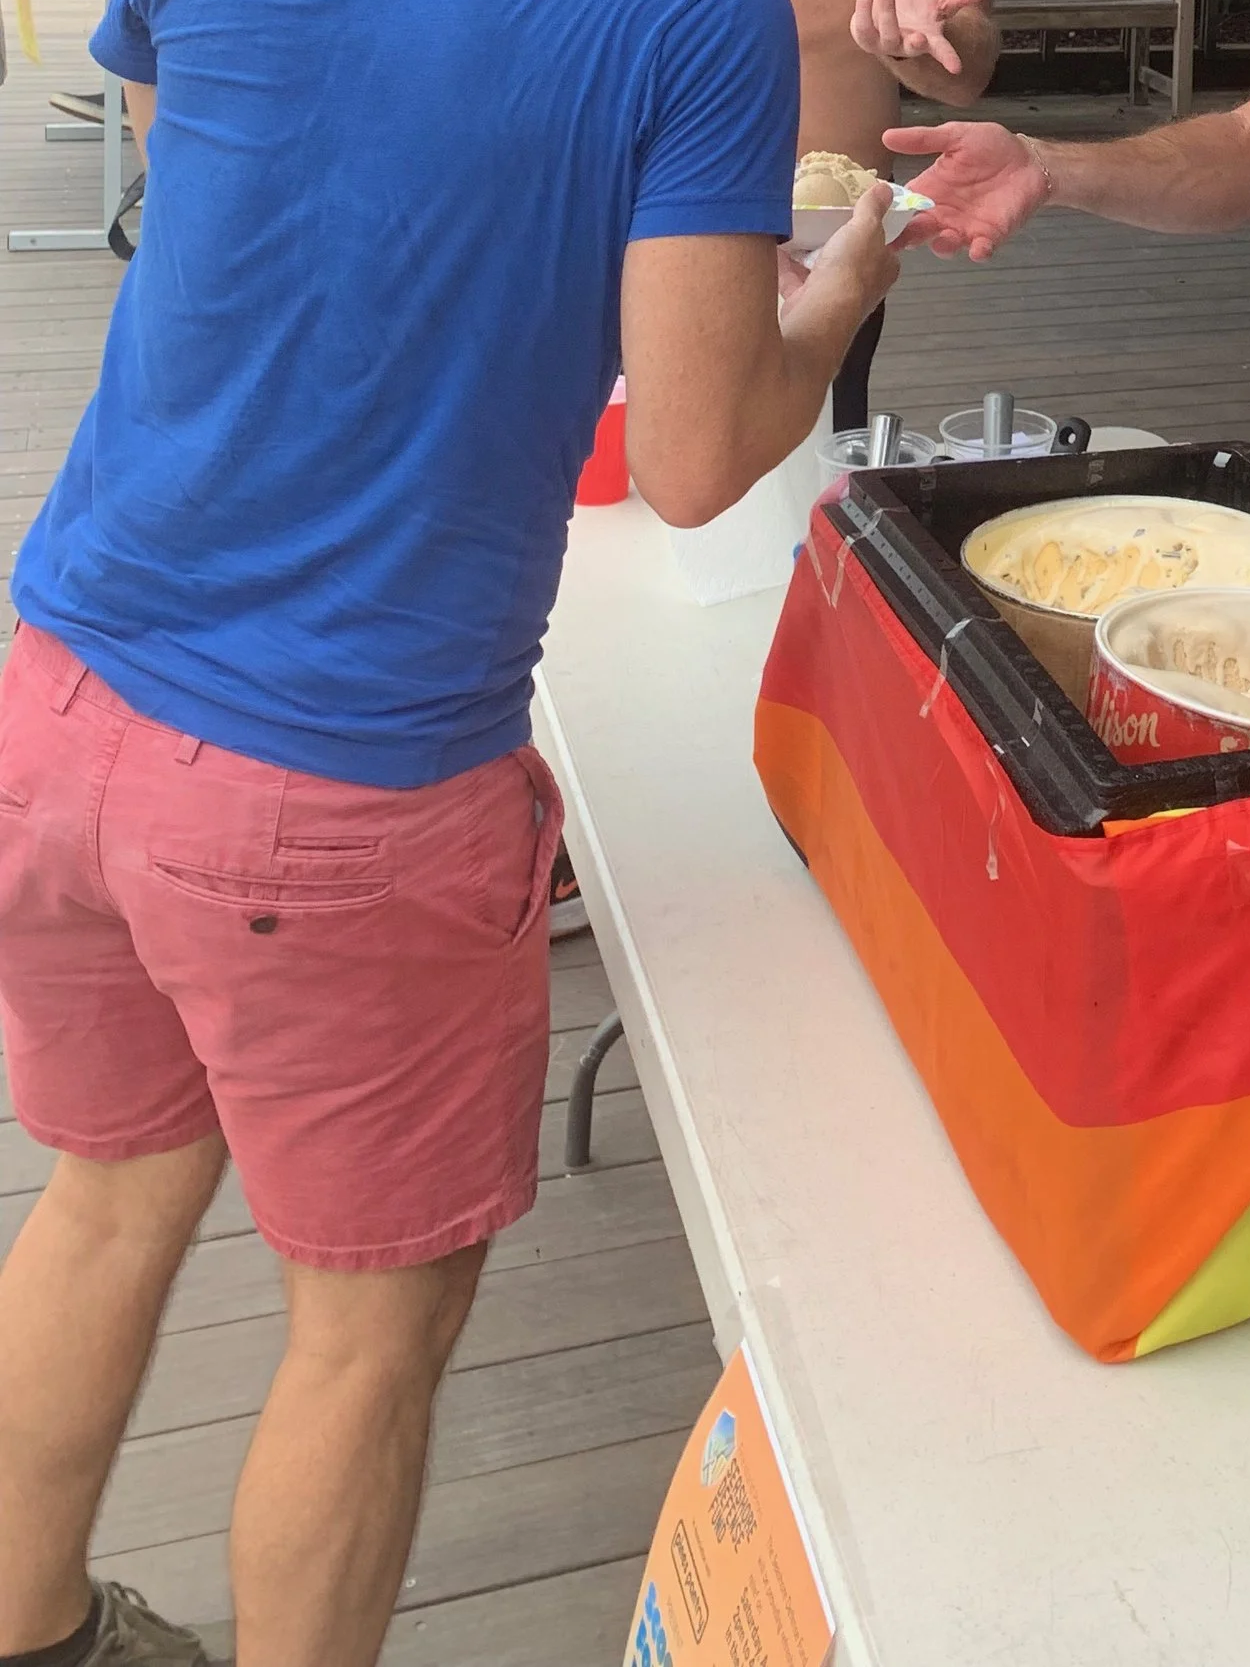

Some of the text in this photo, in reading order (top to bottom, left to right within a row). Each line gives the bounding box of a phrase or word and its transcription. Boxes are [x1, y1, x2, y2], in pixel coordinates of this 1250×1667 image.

[1092, 690, 1161, 748] dison
[708, 1496, 727, 1544] FUND
[717, 1475, 743, 1554] DEFENSE
[727, 1458, 757, 1544] SEASHORE
